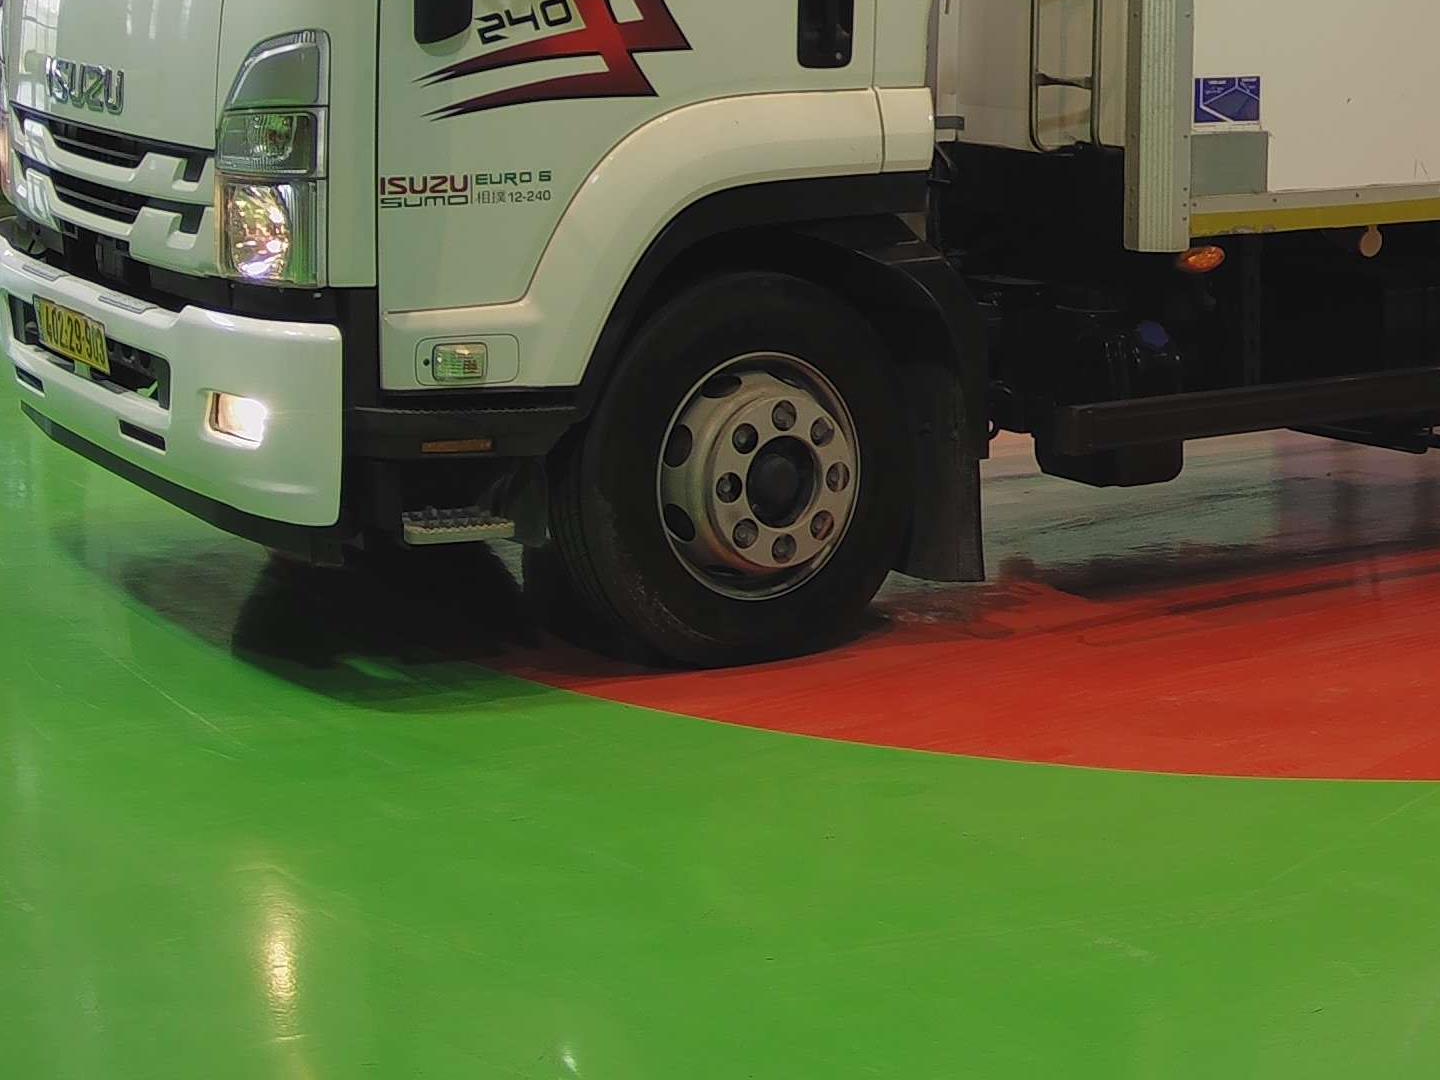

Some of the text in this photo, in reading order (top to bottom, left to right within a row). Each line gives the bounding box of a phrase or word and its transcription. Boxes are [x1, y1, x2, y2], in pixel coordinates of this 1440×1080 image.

[46, 56, 124, 115] ISUZU
[380, 174, 468, 195] ISUZU
[475, 171, 532, 186] EURO
[380, 195, 468, 208] SUMO
[508, 190, 551, 203] 12-240
